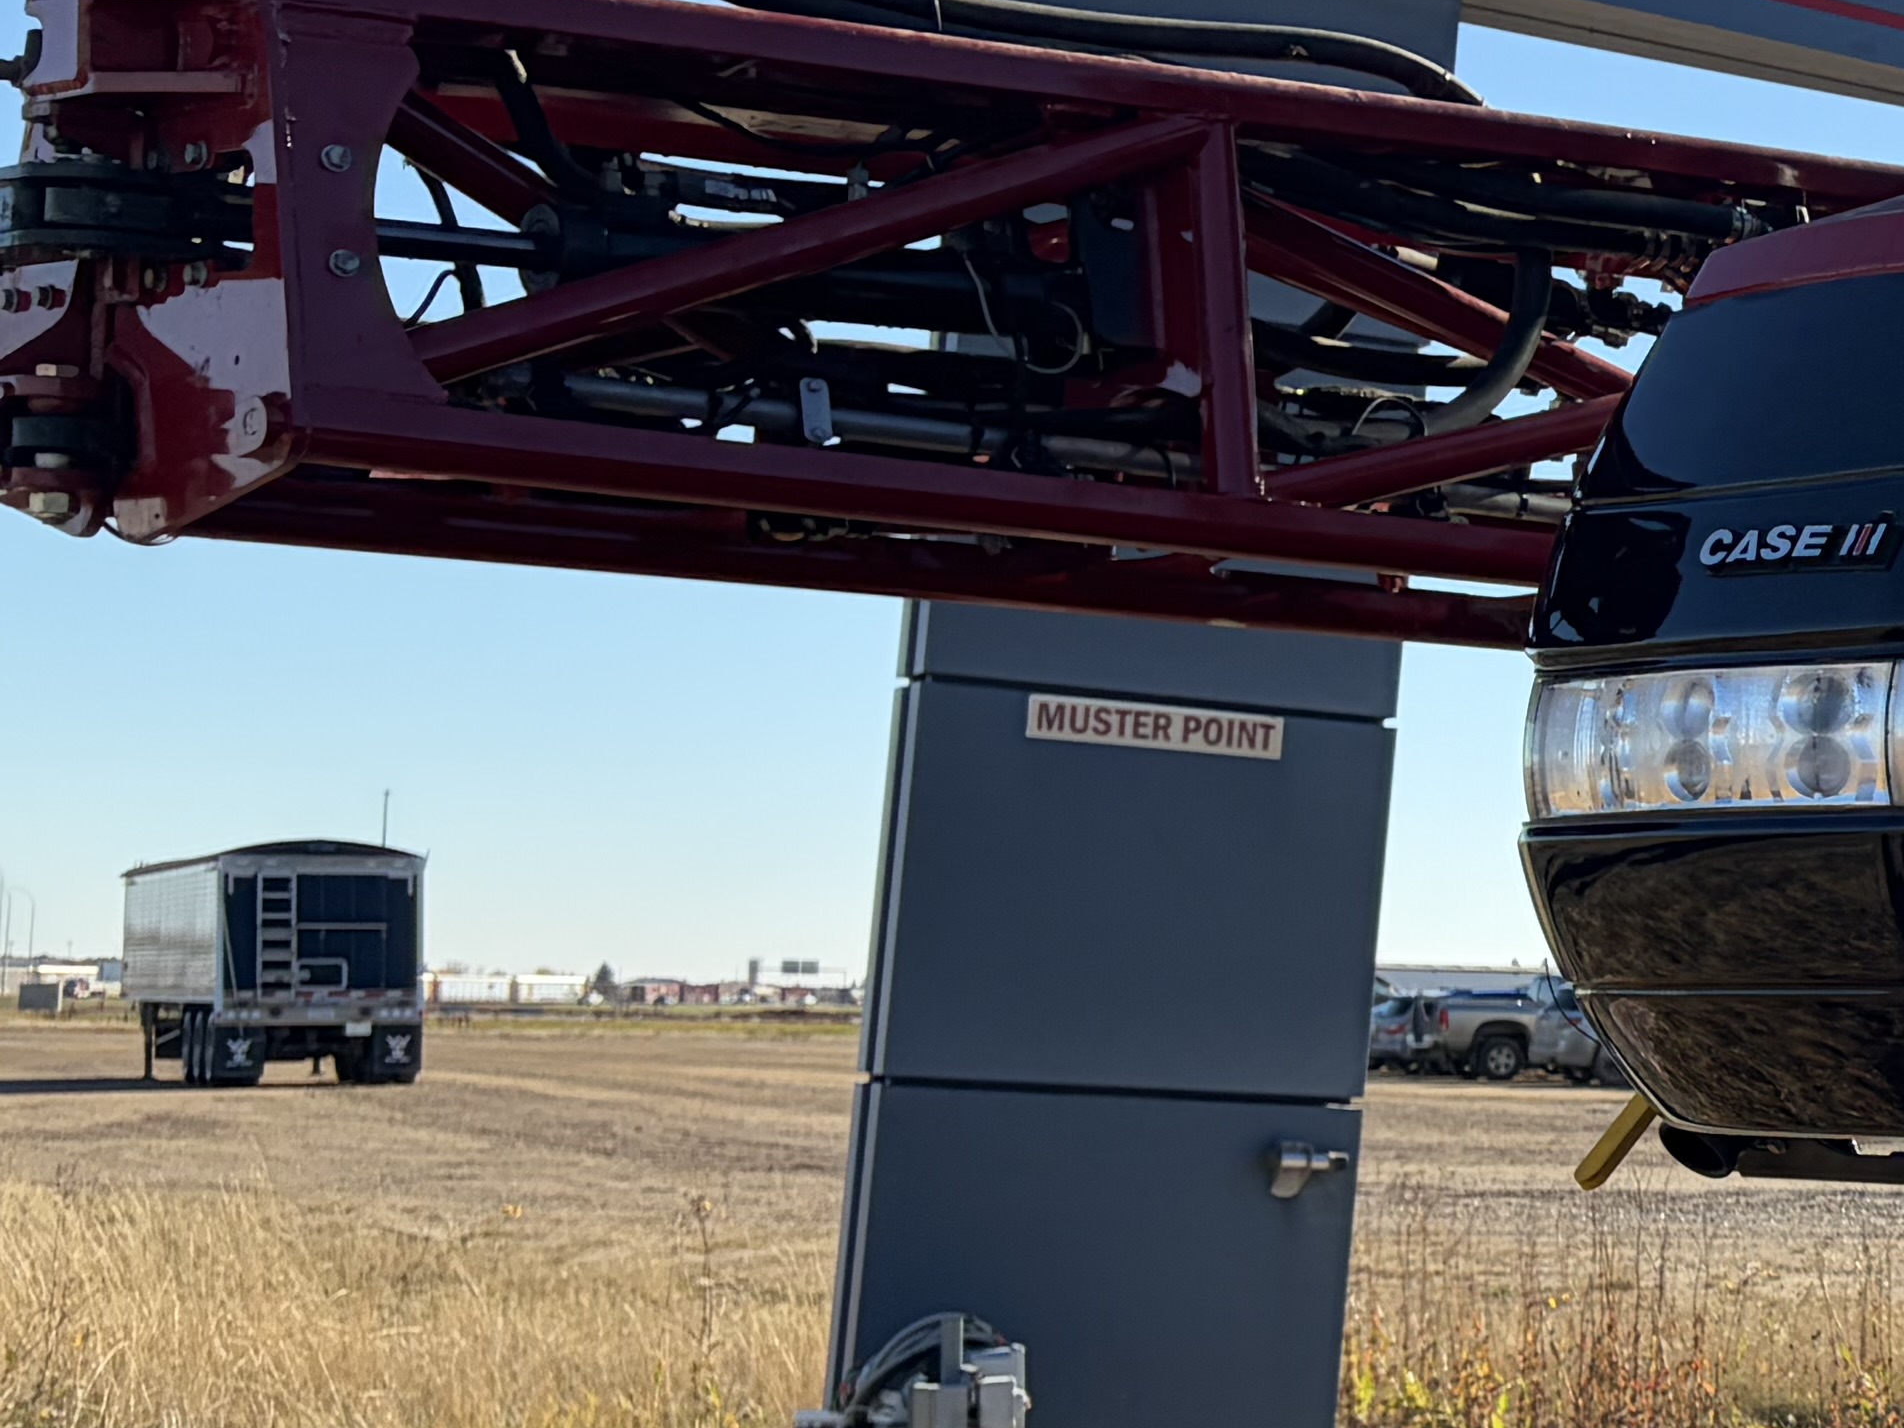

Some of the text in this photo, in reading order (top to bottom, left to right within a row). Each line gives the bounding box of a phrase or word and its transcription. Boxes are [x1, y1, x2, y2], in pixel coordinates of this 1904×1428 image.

[1700, 525, 1833, 565] CASE
[1037, 703, 1276, 752] MUSTER POINT
